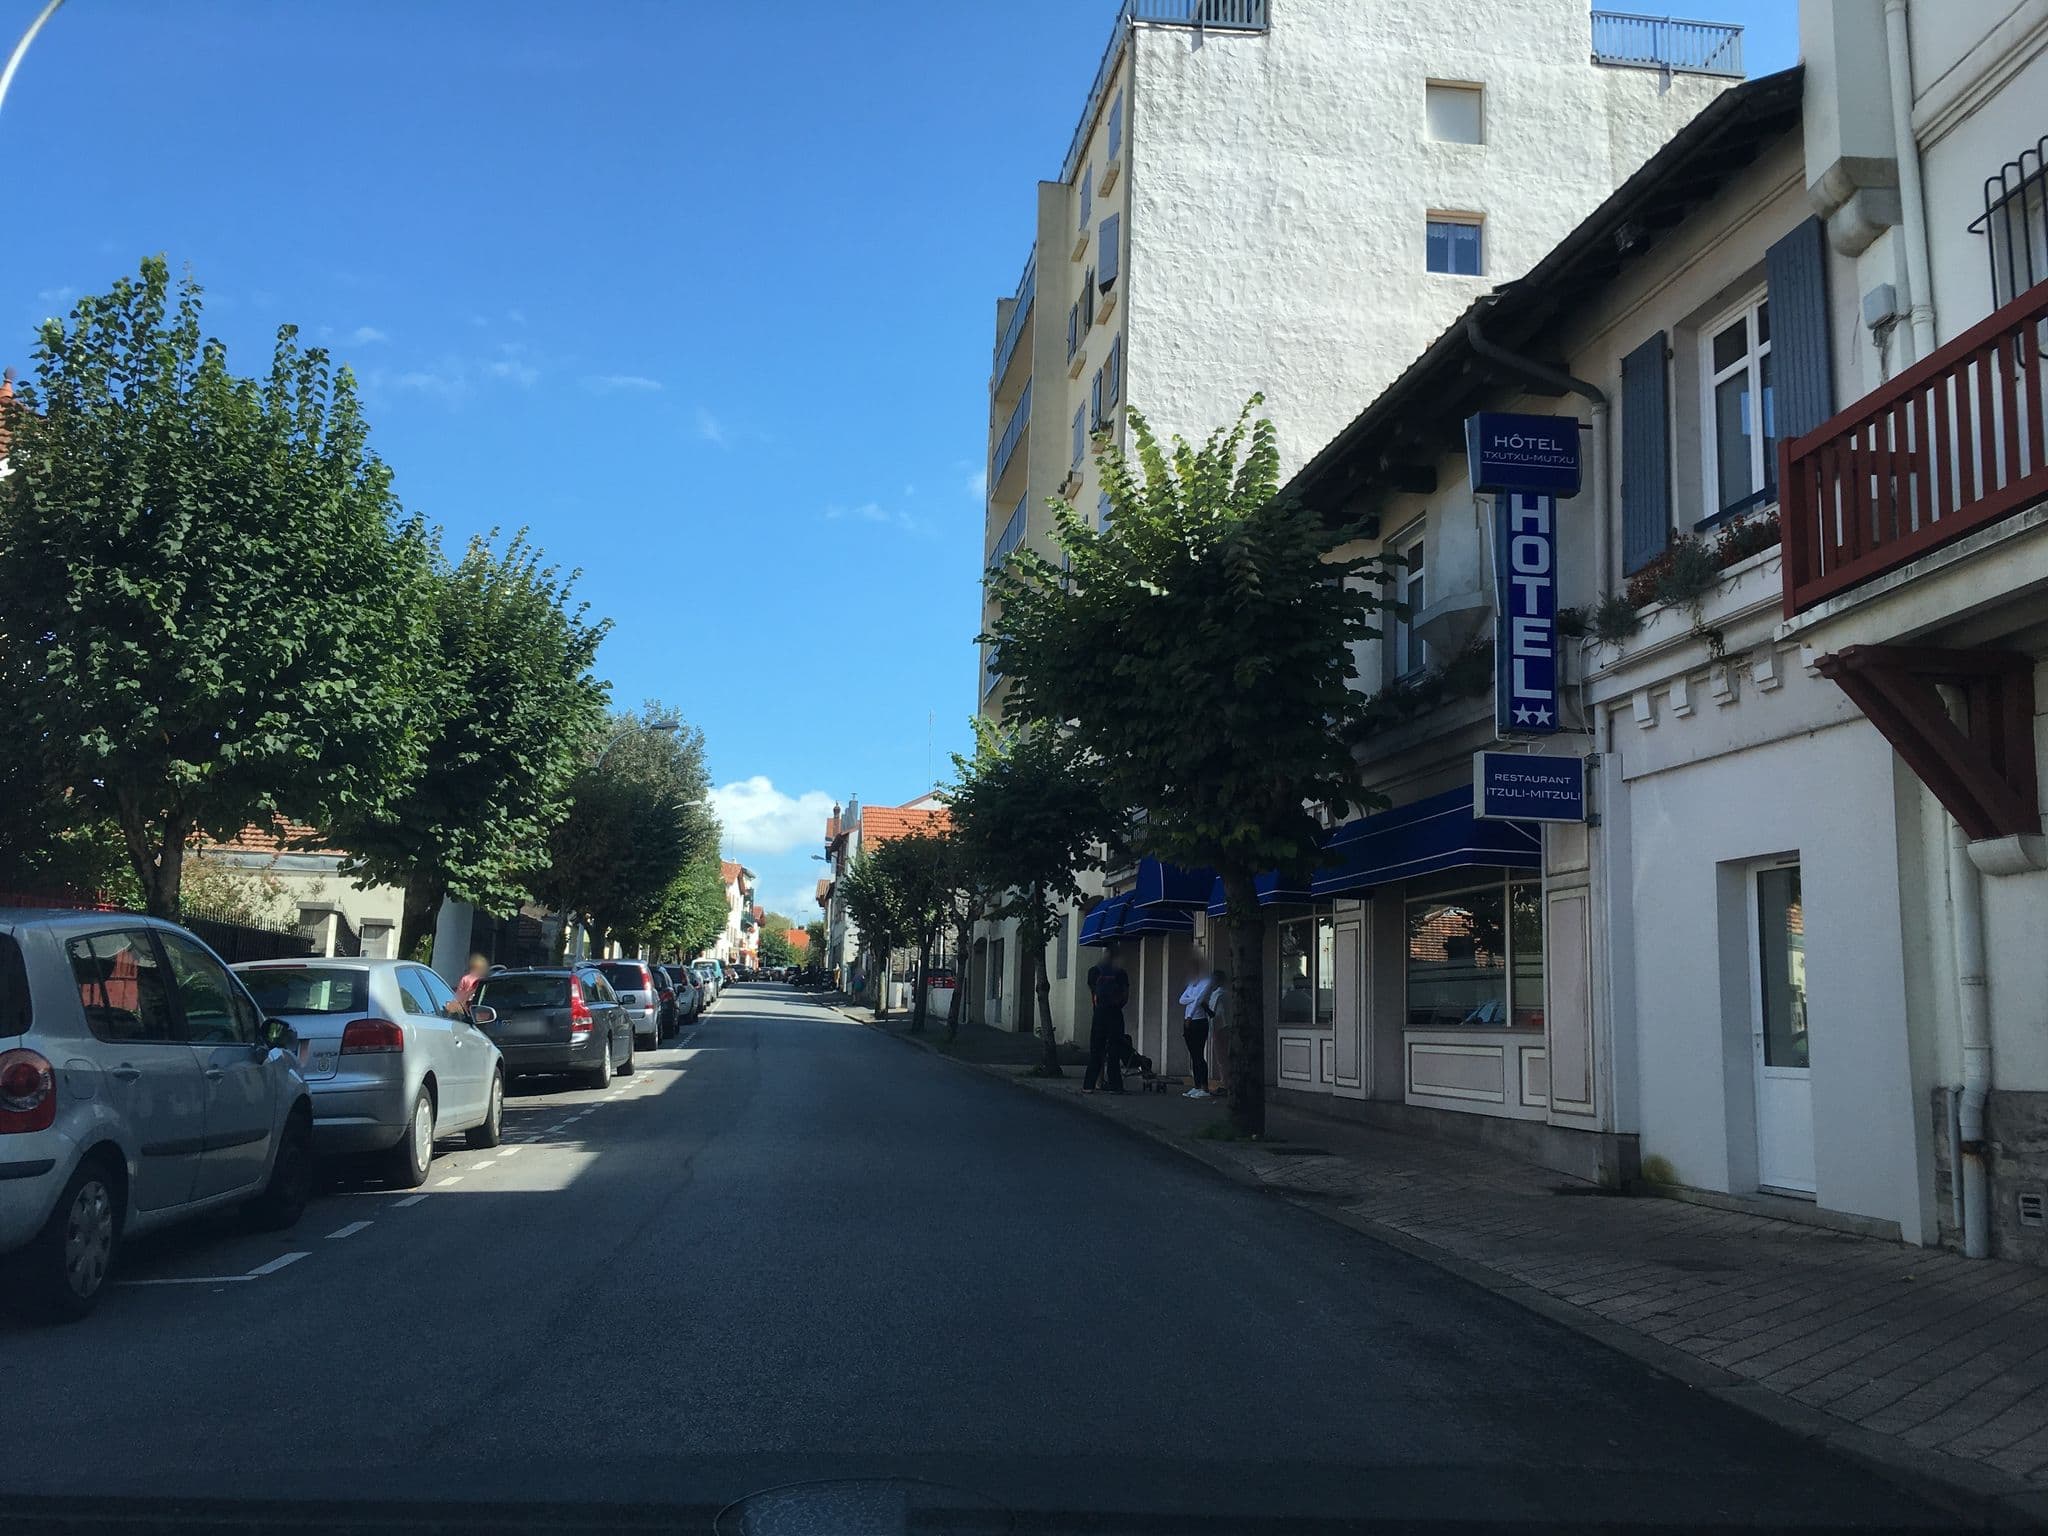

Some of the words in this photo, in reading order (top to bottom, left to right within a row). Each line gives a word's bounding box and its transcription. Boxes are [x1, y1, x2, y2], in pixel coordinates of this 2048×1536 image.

[1494, 433, 1563, 451] HÔTEL
[1483, 451, 1575, 464] TXUTXU-MUTXU
[1511, 493, 1552, 700] HOTEL
[1494, 773, 1571, 784] RESTAURANT
[1486, 787, 1581, 800] ITZULI-MITZULI
